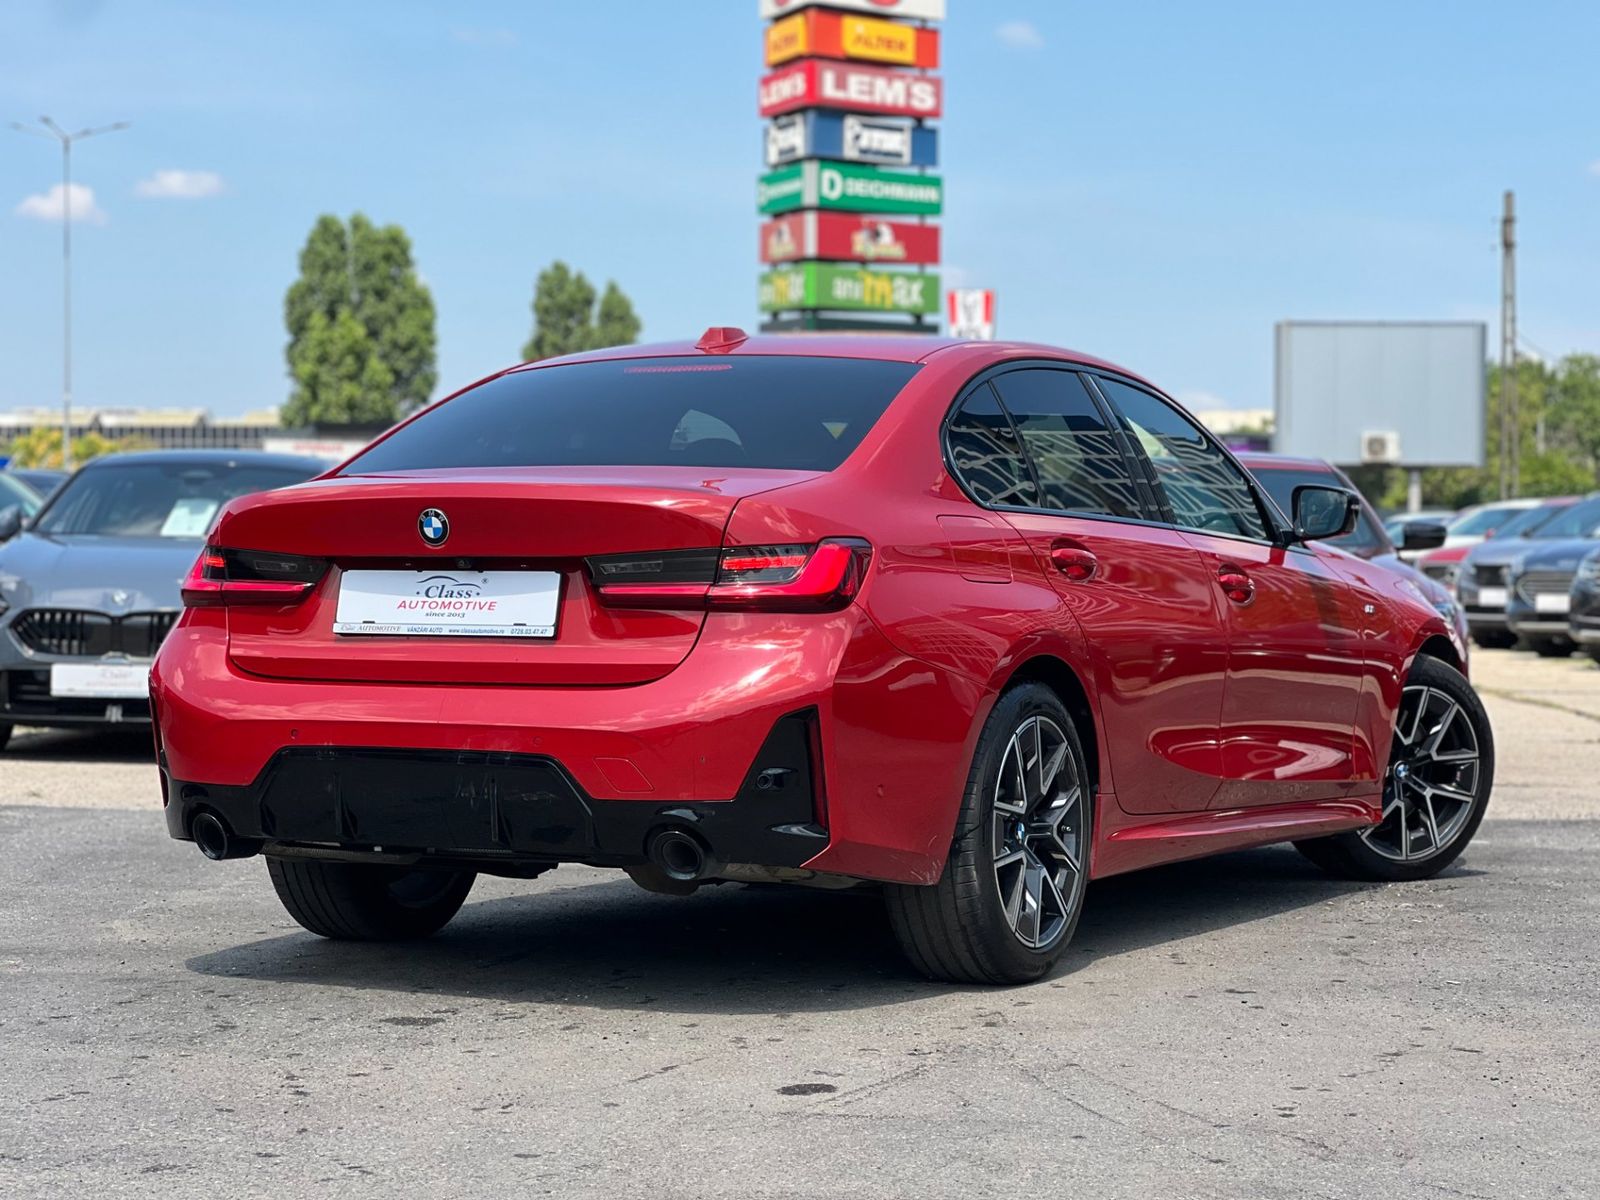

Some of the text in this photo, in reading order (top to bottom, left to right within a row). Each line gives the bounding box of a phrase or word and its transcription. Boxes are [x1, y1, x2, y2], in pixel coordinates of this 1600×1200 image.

[821, 69, 937, 111] LEM'S
[424, 585, 473, 599] Class
[397, 600, 497, 611] AUTOMOTIVE
[357, 624, 401, 632] AUTOMOTIVE
